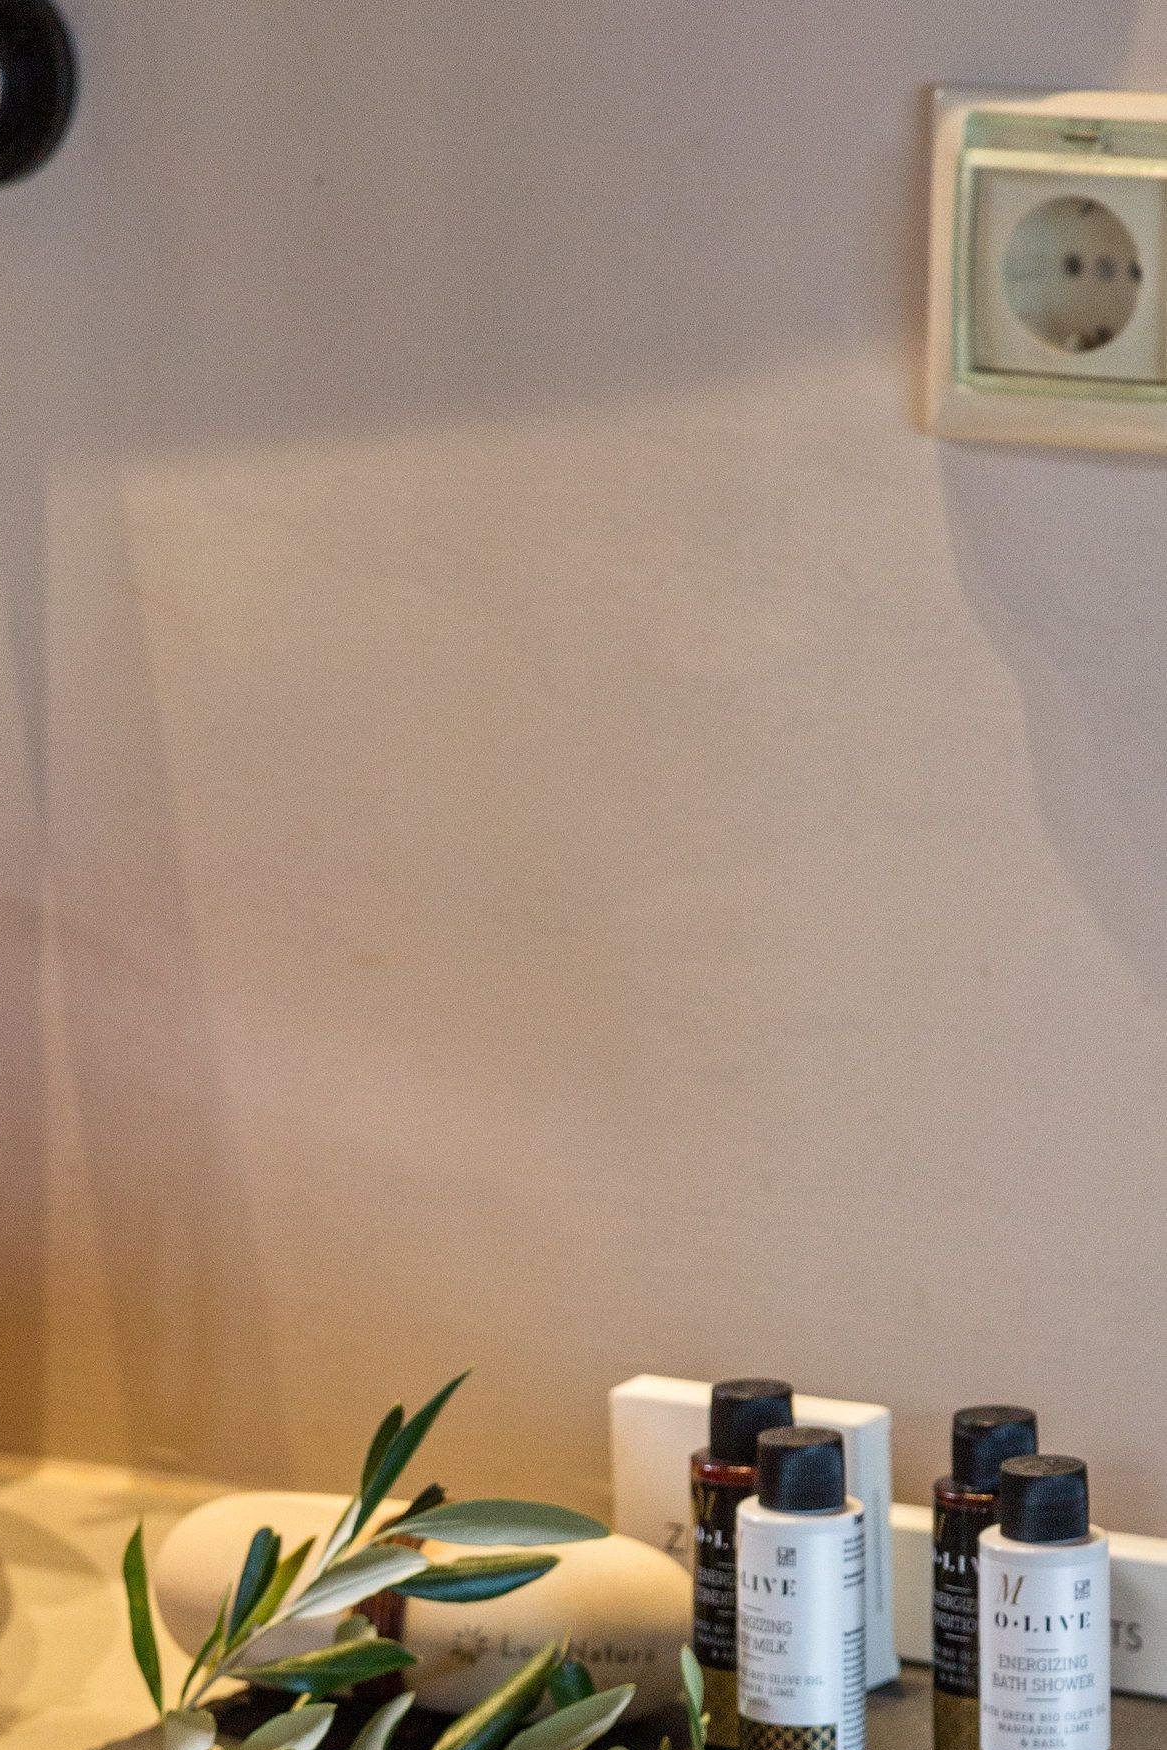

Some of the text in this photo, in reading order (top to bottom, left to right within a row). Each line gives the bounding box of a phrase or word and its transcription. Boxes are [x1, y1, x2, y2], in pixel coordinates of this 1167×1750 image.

[998, 1653, 1089, 1673] ENERGIZING
[992, 1671, 1096, 1692] BATH SHOWER
